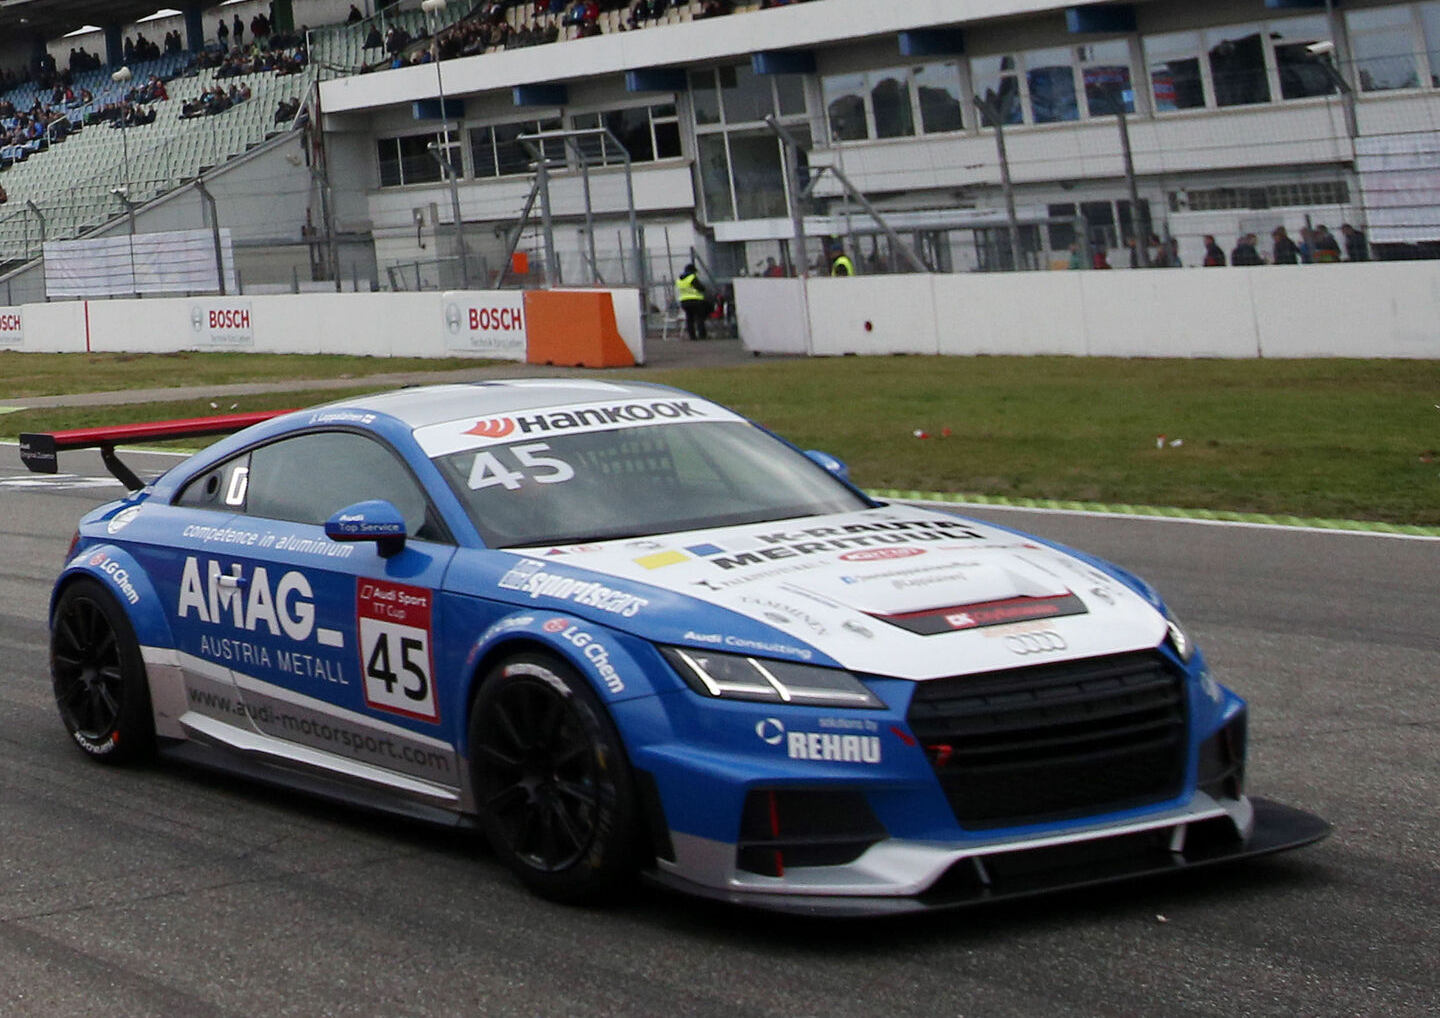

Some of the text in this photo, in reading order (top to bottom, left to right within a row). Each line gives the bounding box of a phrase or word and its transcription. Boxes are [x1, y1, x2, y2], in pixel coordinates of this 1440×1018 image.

[209, 310, 250, 329] BOSCH
[468, 308, 522, 330] BOSCH
[467, 442, 575, 491] 45
[339, 514, 364, 522] Audi
[339, 522, 401, 532] Top Service
[757, 520, 976, 544] K-RAUTA
[182, 523, 355, 559] competence in aluminium
[710, 530, 988, 570] MERITUULI
[373, 587, 428, 608] Audi Sport
[373, 602, 407, 620] TT Cup
[200, 634, 350, 685] AUSTRIA METALL
[683, 630, 813, 660] Audi Consulting
[367, 632, 429, 702] 45
[188, 686, 450, 772] www.audi-motorsport.com
[787, 731, 881, 763] REHAU
